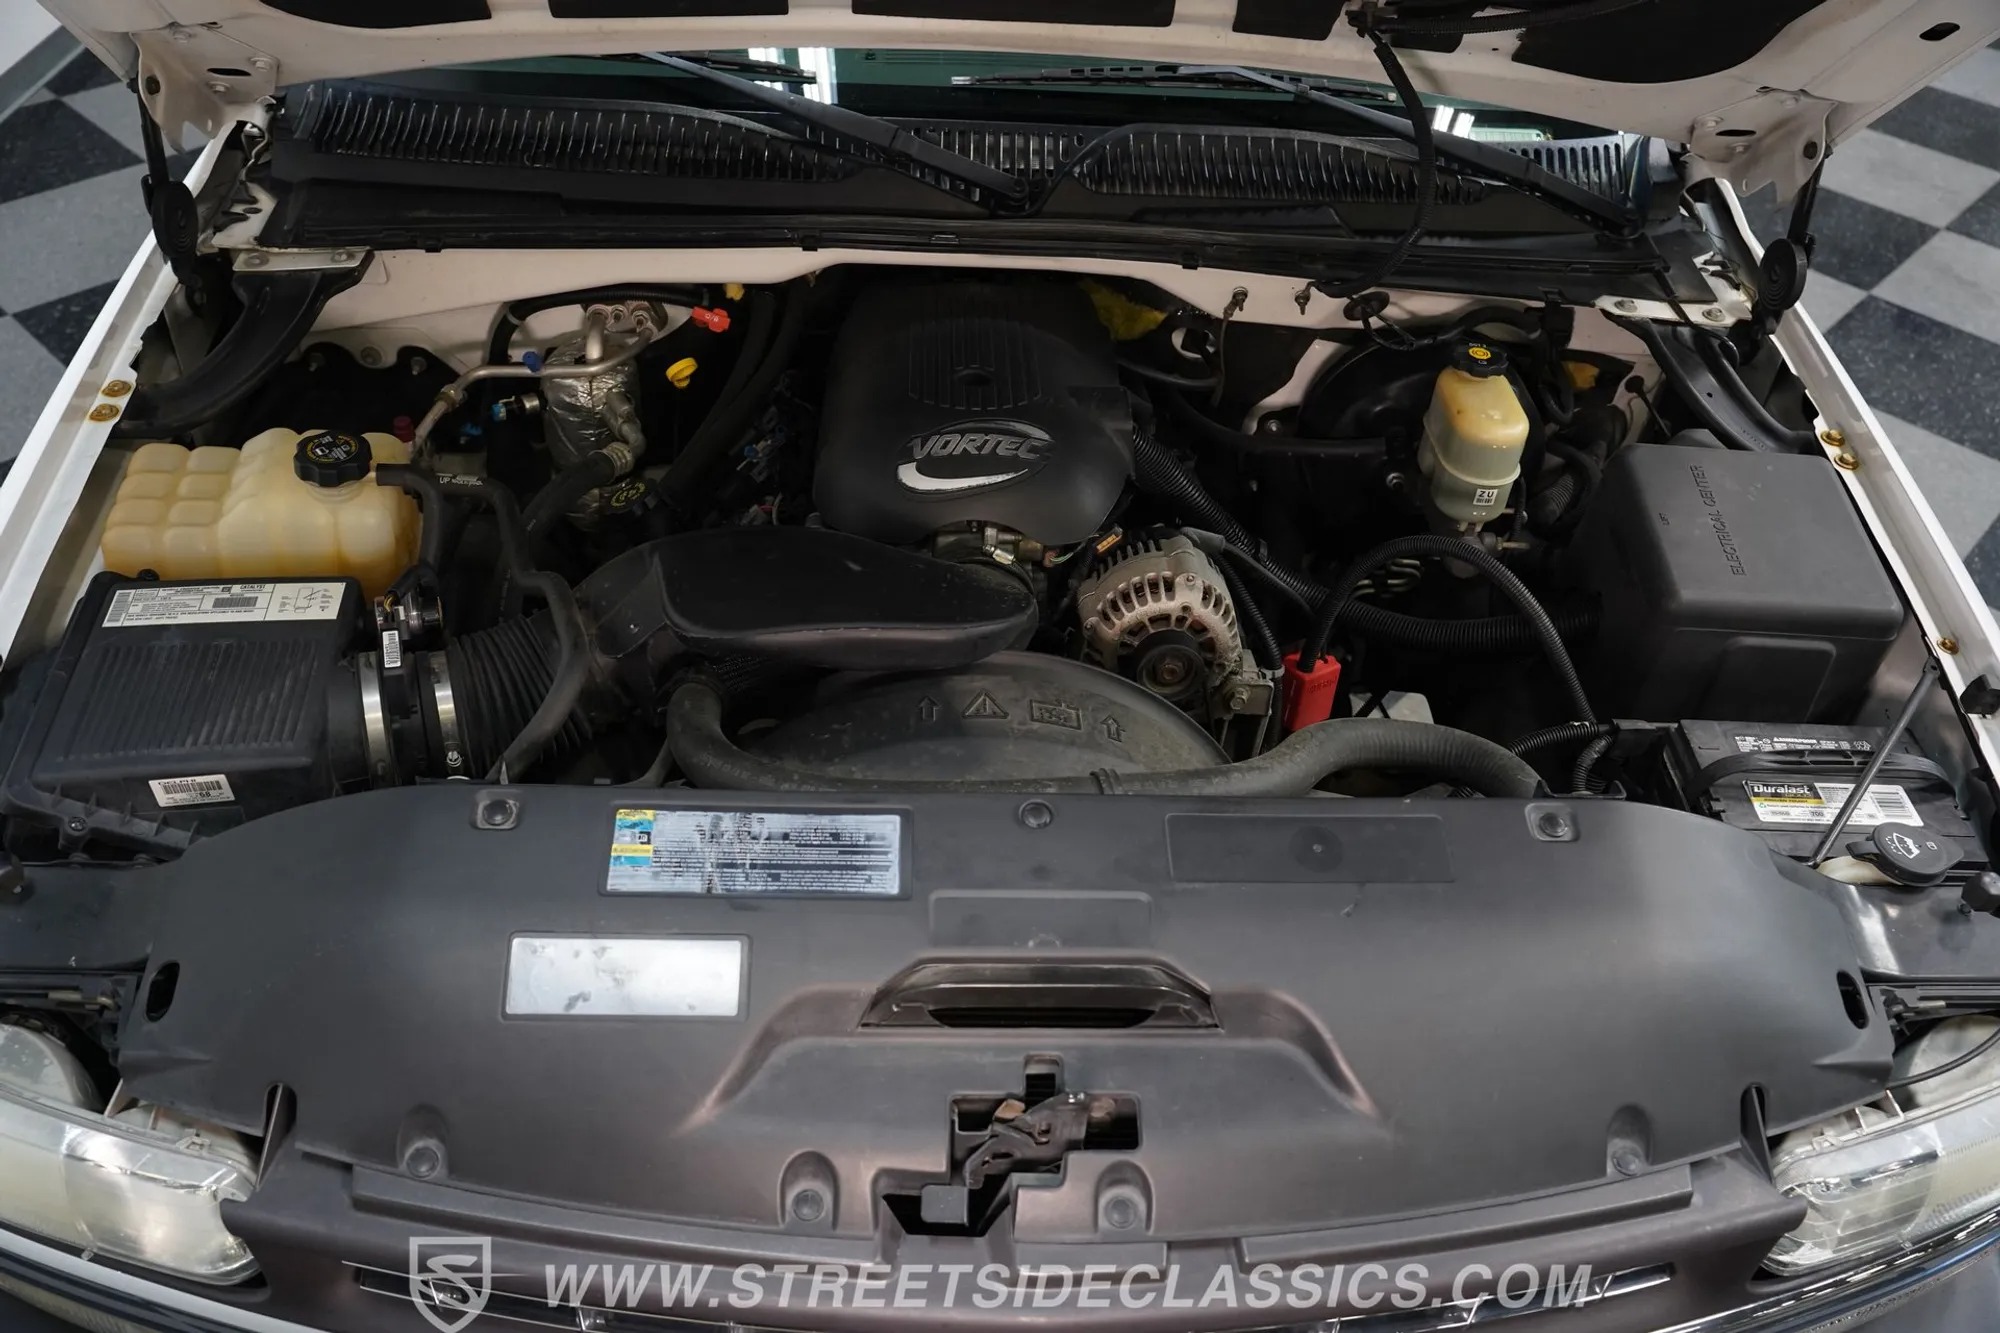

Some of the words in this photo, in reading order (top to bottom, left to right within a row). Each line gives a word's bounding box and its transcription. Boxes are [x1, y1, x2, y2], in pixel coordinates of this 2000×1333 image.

[907, 433, 1049, 460] VORTEC
[1689, 464, 1716, 507] CENTER
[1708, 509, 1747, 576] ELECTRICAL
[1753, 784, 1810, 794] Duralast
